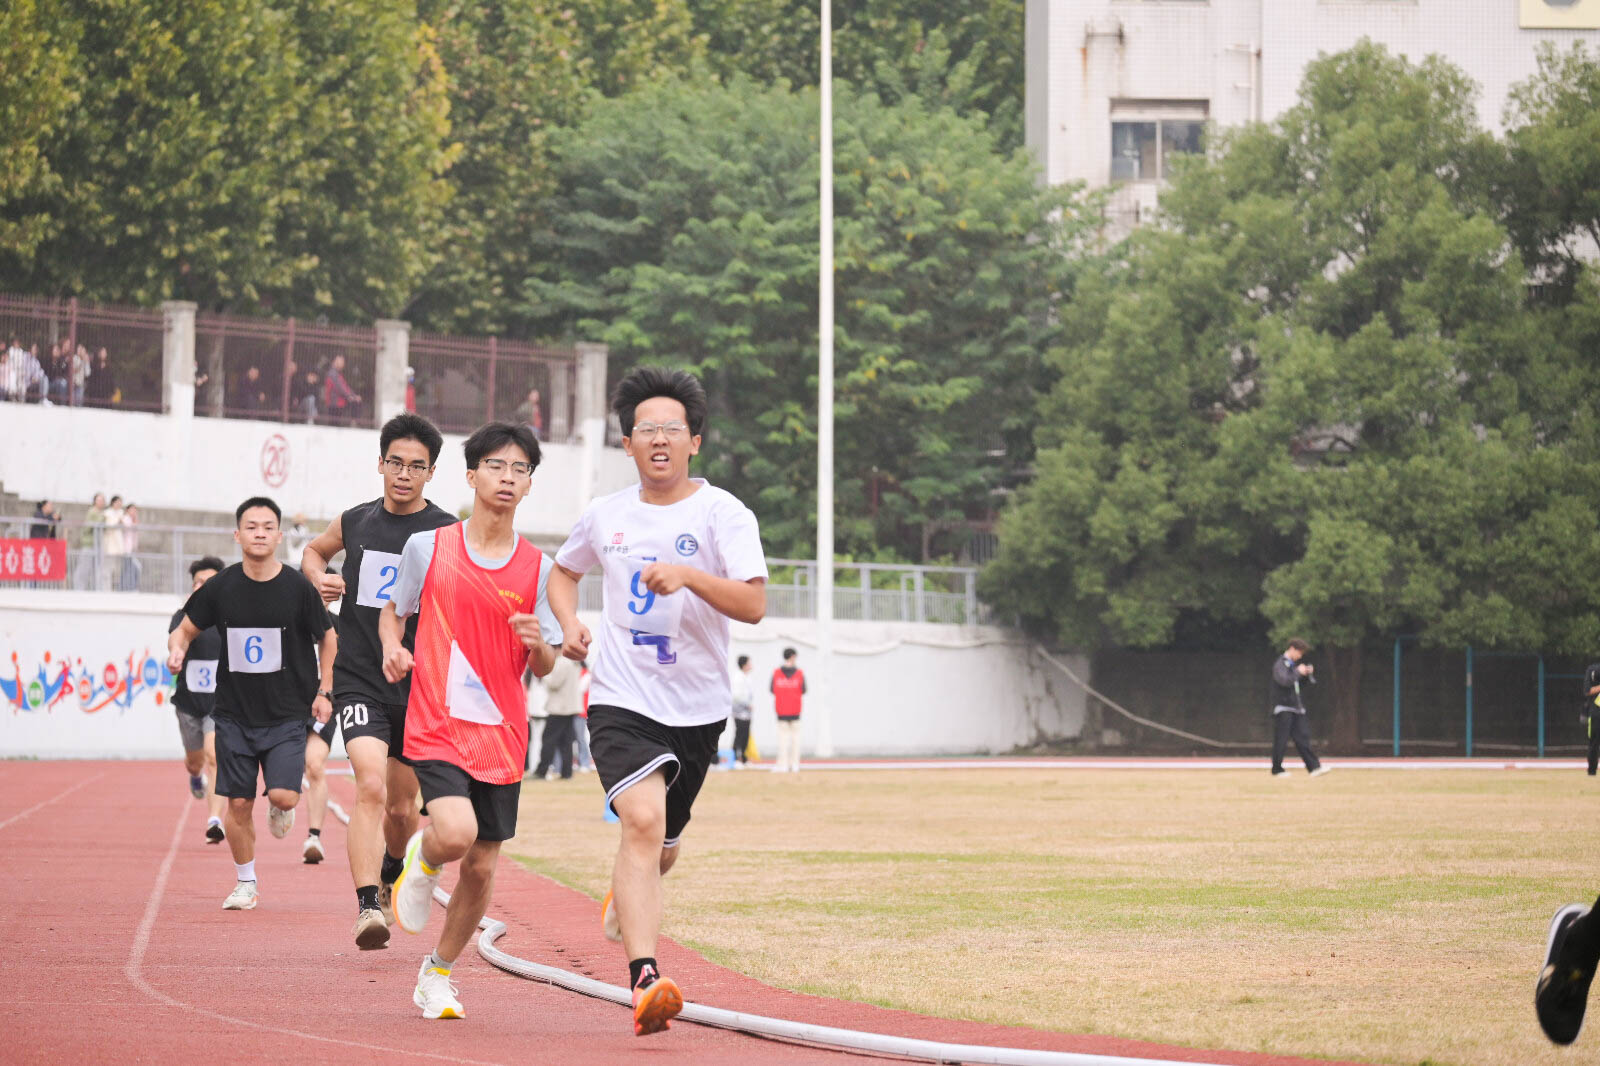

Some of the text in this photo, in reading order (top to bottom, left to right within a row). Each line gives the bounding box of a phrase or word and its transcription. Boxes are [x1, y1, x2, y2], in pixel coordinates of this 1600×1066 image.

[376, 566, 398, 600] 2
[628, 571, 656, 615] 9
[244, 635, 263, 664] 6
[198, 667, 211, 687] 3
[343, 704, 369, 730] 20
